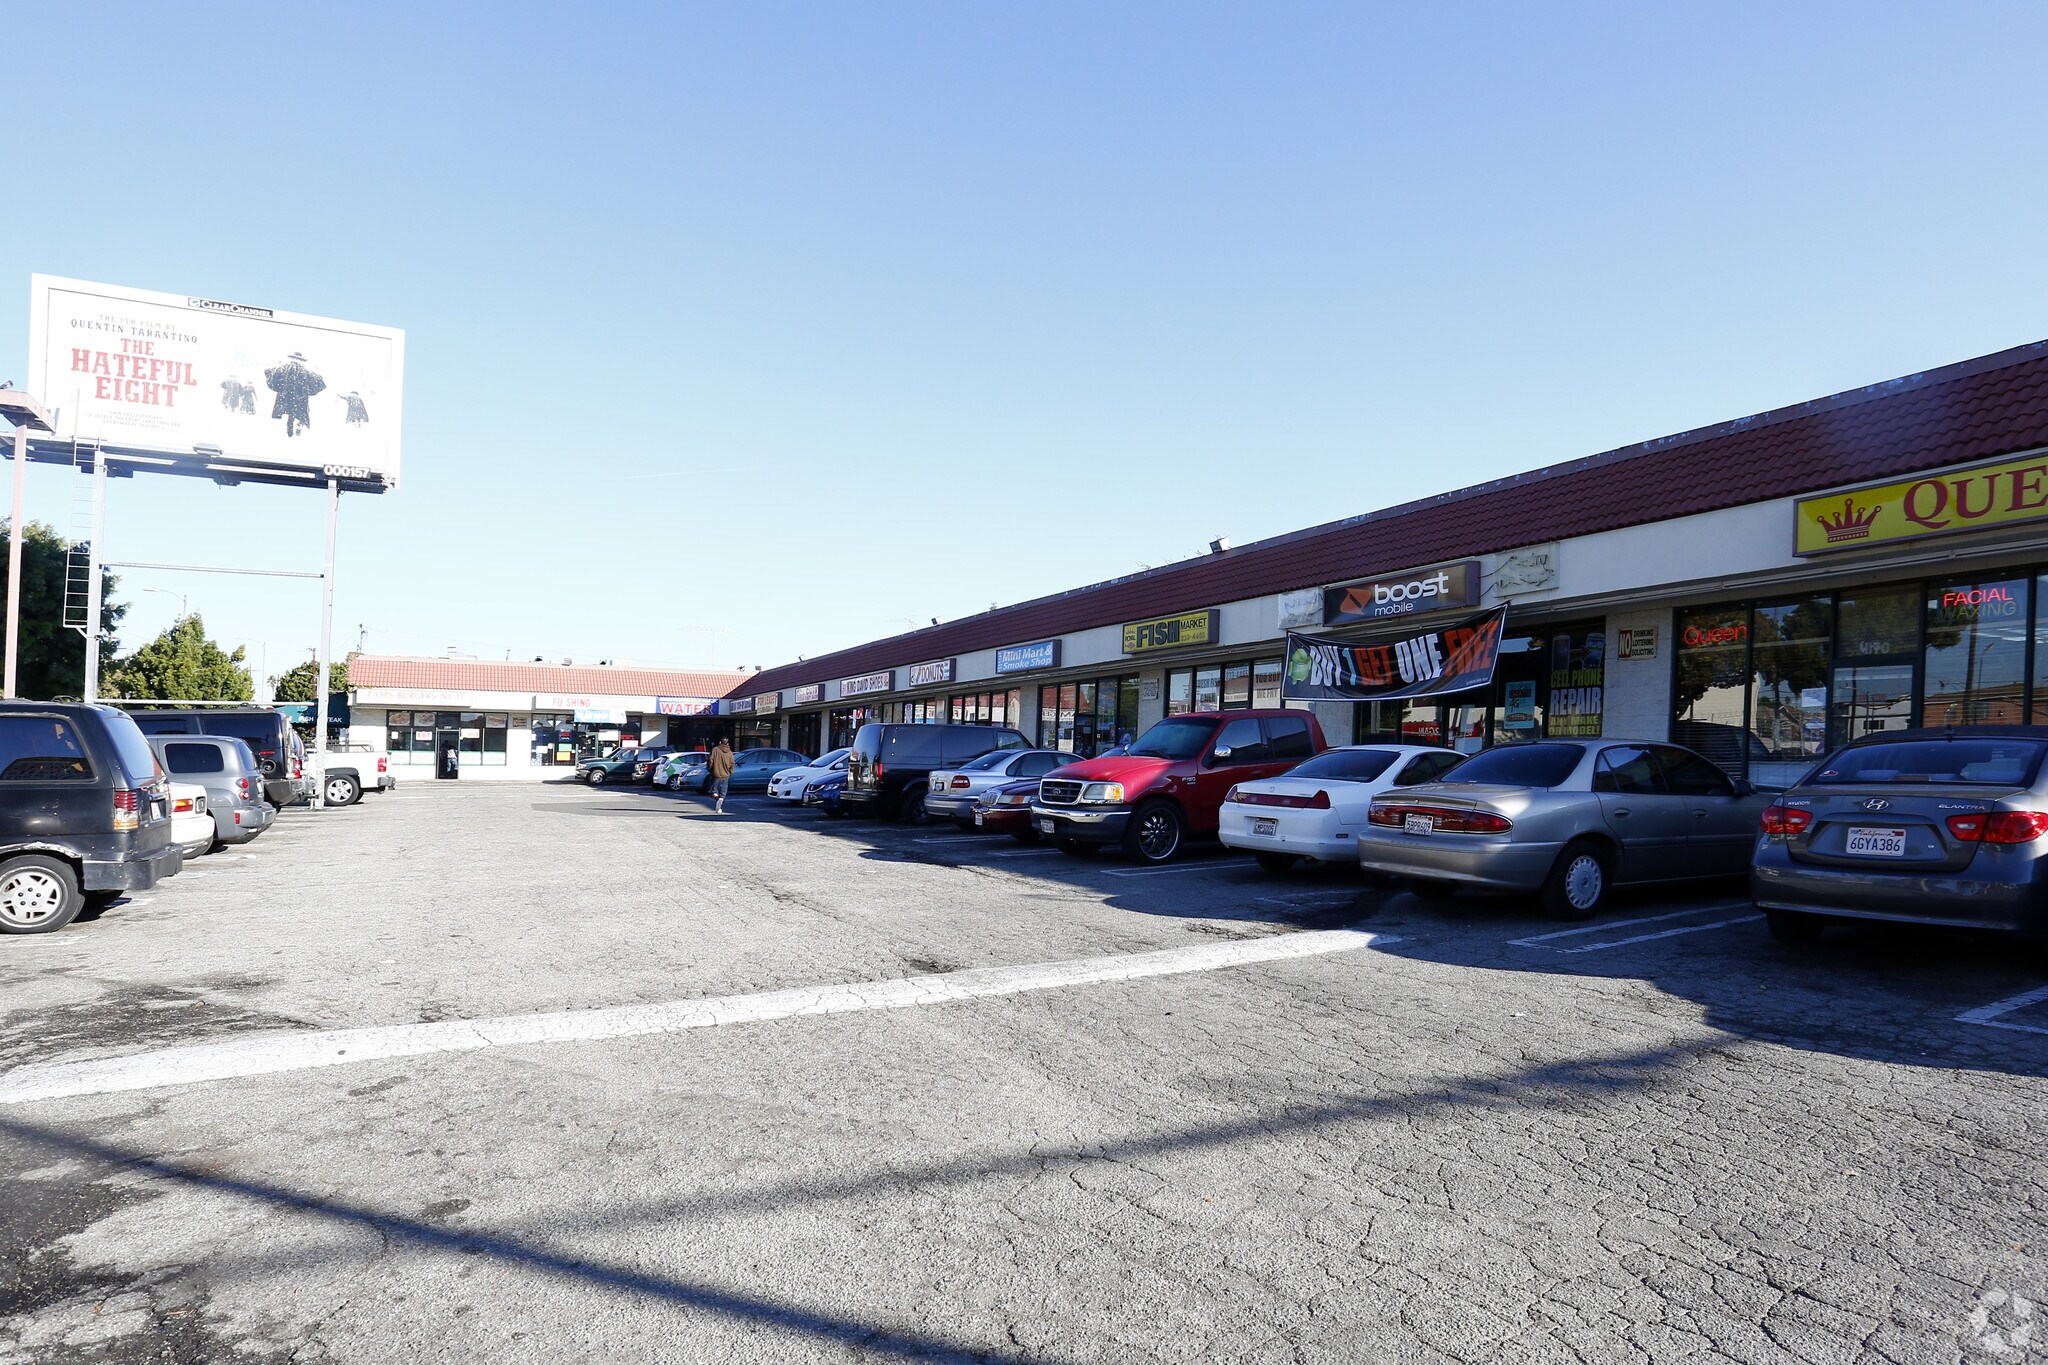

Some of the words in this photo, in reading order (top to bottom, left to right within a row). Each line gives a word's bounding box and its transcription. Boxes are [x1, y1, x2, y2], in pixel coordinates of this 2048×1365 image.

[71, 318, 124, 334] QUENTIN
[131, 326, 198, 344] TARANTINO
[120, 338, 155, 356] THE
[71, 347, 198, 386] HATEFUL
[94, 376, 179, 407] EIGHT
[323, 465, 370, 479] 000157
[1374, 571, 1449, 605] boost
[1943, 588, 2014, 608] FACIAL
[1374, 602, 1414, 617] mobile
[1939, 601, 2017, 619] WAXING
[1136, 620, 1180, 648] FISH
[1180, 617, 1207, 630] MARKET
[1633, 629, 1654, 637] DRINKING
[1682, 623, 1748, 645] Queen
[1619, 632, 1631, 655] NO
[1632, 638, 1654, 646] LOITERING
[1002, 650, 1021, 663] Mini
[1022, 646, 1043, 660] Mart
[1044, 644, 1053, 656] &
[1309, 646, 1342, 687] BUY
[1342, 647, 1357, 686] 1
[1354, 645, 1393, 687] GET
[1394, 633, 1444, 684] ONE
[1443, 619, 1500, 676] FREE
[1631, 648, 1654, 656] SOLICITING
[1002, 661, 1029, 670] Smoke
[1030, 656, 1052, 666] Shop
[921, 662, 944, 683] DONUTS
[1255, 673, 1269, 684] YOU
[1269, 671, 1281, 683] BUY
[1550, 671, 1570, 688] CELL
[1571, 668, 1602, 686] PHONE
[847, 680, 857, 694] KING
[856, 677, 869, 693] DAVID
[869, 675, 884, 691] SHOES
[1256, 688, 1267, 699] WE
[1266, 687, 1279, 698] FRY
[397, 691, 437, 700] BURGERS
[552, 697, 563, 707] FU
[566, 698, 591, 708] SHING
[1549, 687, 1602, 716] REPAIR
[660, 702, 713, 716] WATER
[1549, 716, 1569, 726] ANY
[1570, 715, 1599, 725] MAKE
[1859, 828, 1892, 839] California
[1849, 836, 1901, 852] 6GYA386
